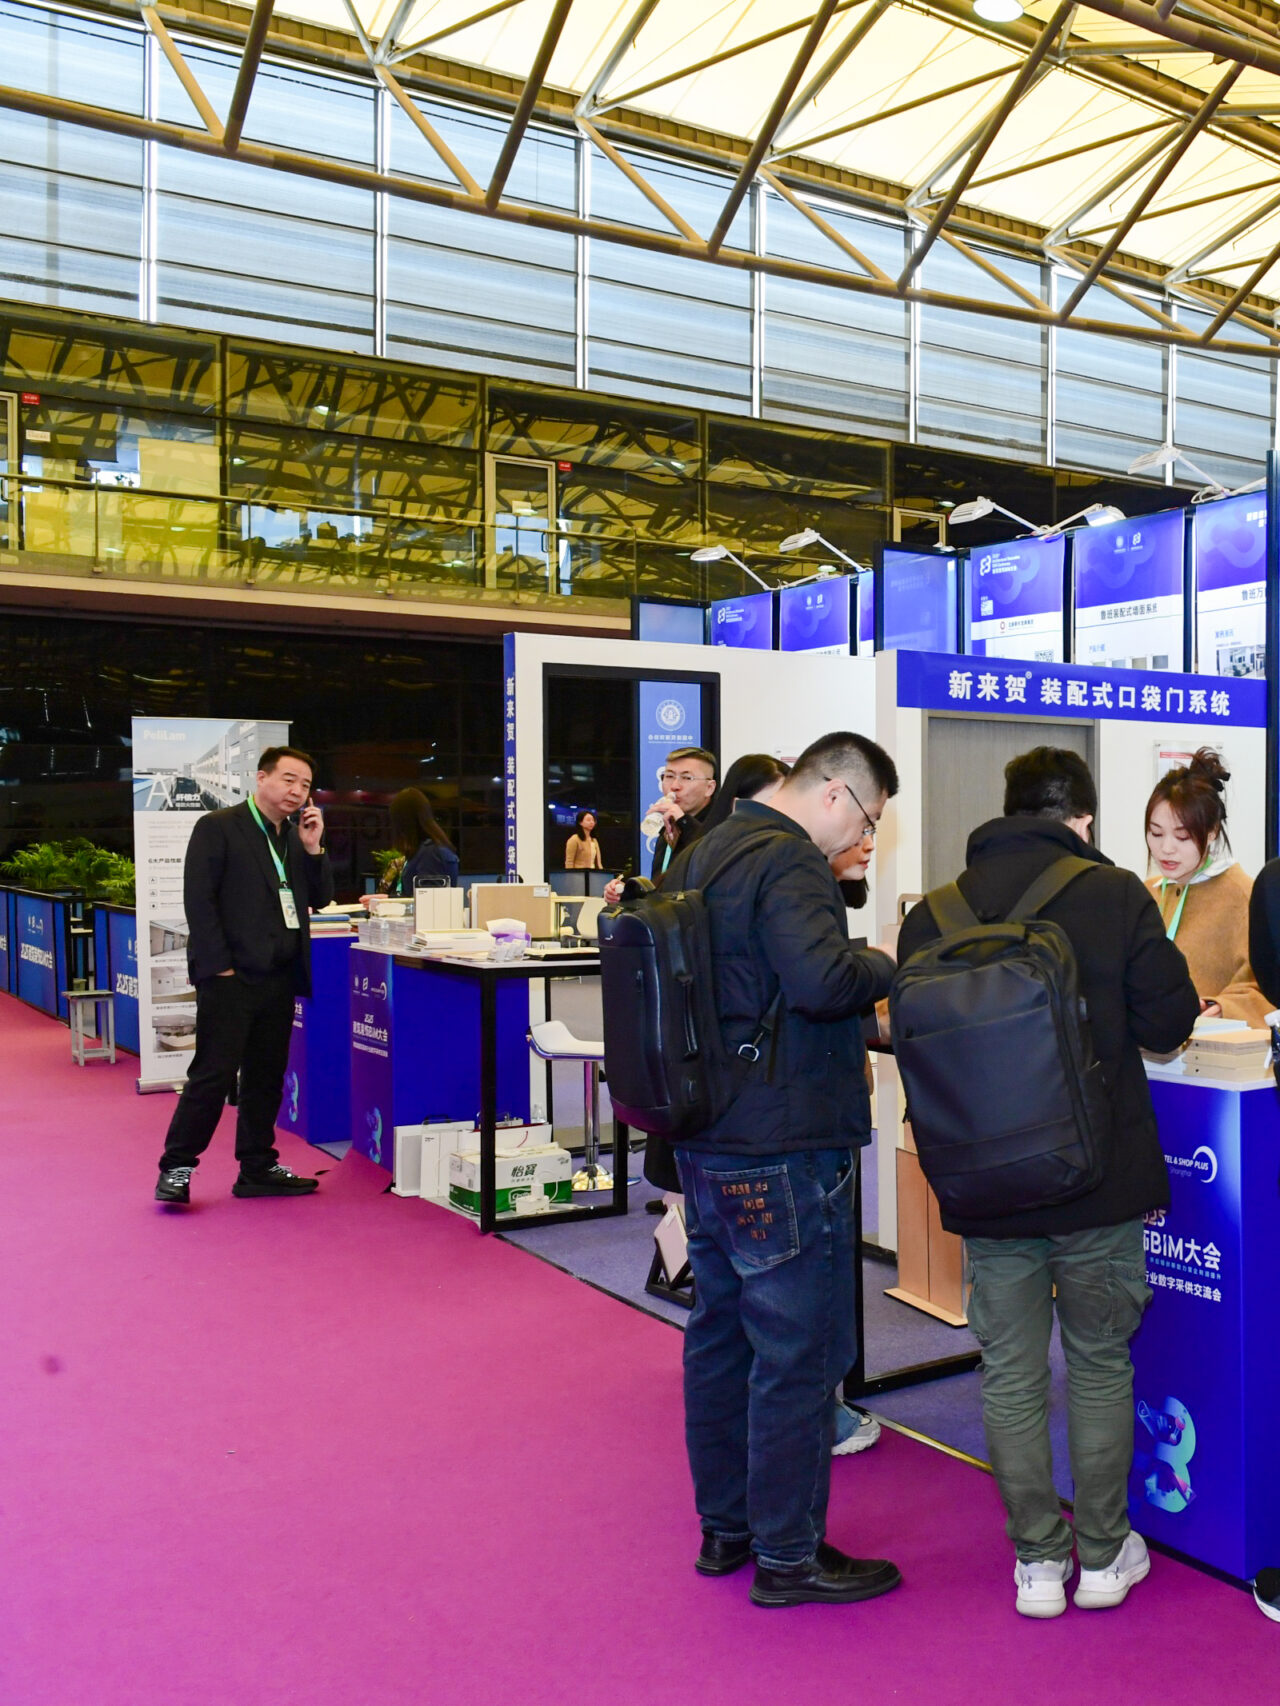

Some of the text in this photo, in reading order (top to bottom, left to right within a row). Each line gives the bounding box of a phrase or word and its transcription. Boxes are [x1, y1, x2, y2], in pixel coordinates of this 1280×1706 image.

[1242, 587, 1266, 600] 鲁班万
[1041, 678, 1230, 717] 装配式口袋门系统
[1179, 1157, 1194, 1167] SHOP
[1194, 1159, 1209, 1171] PLUS
